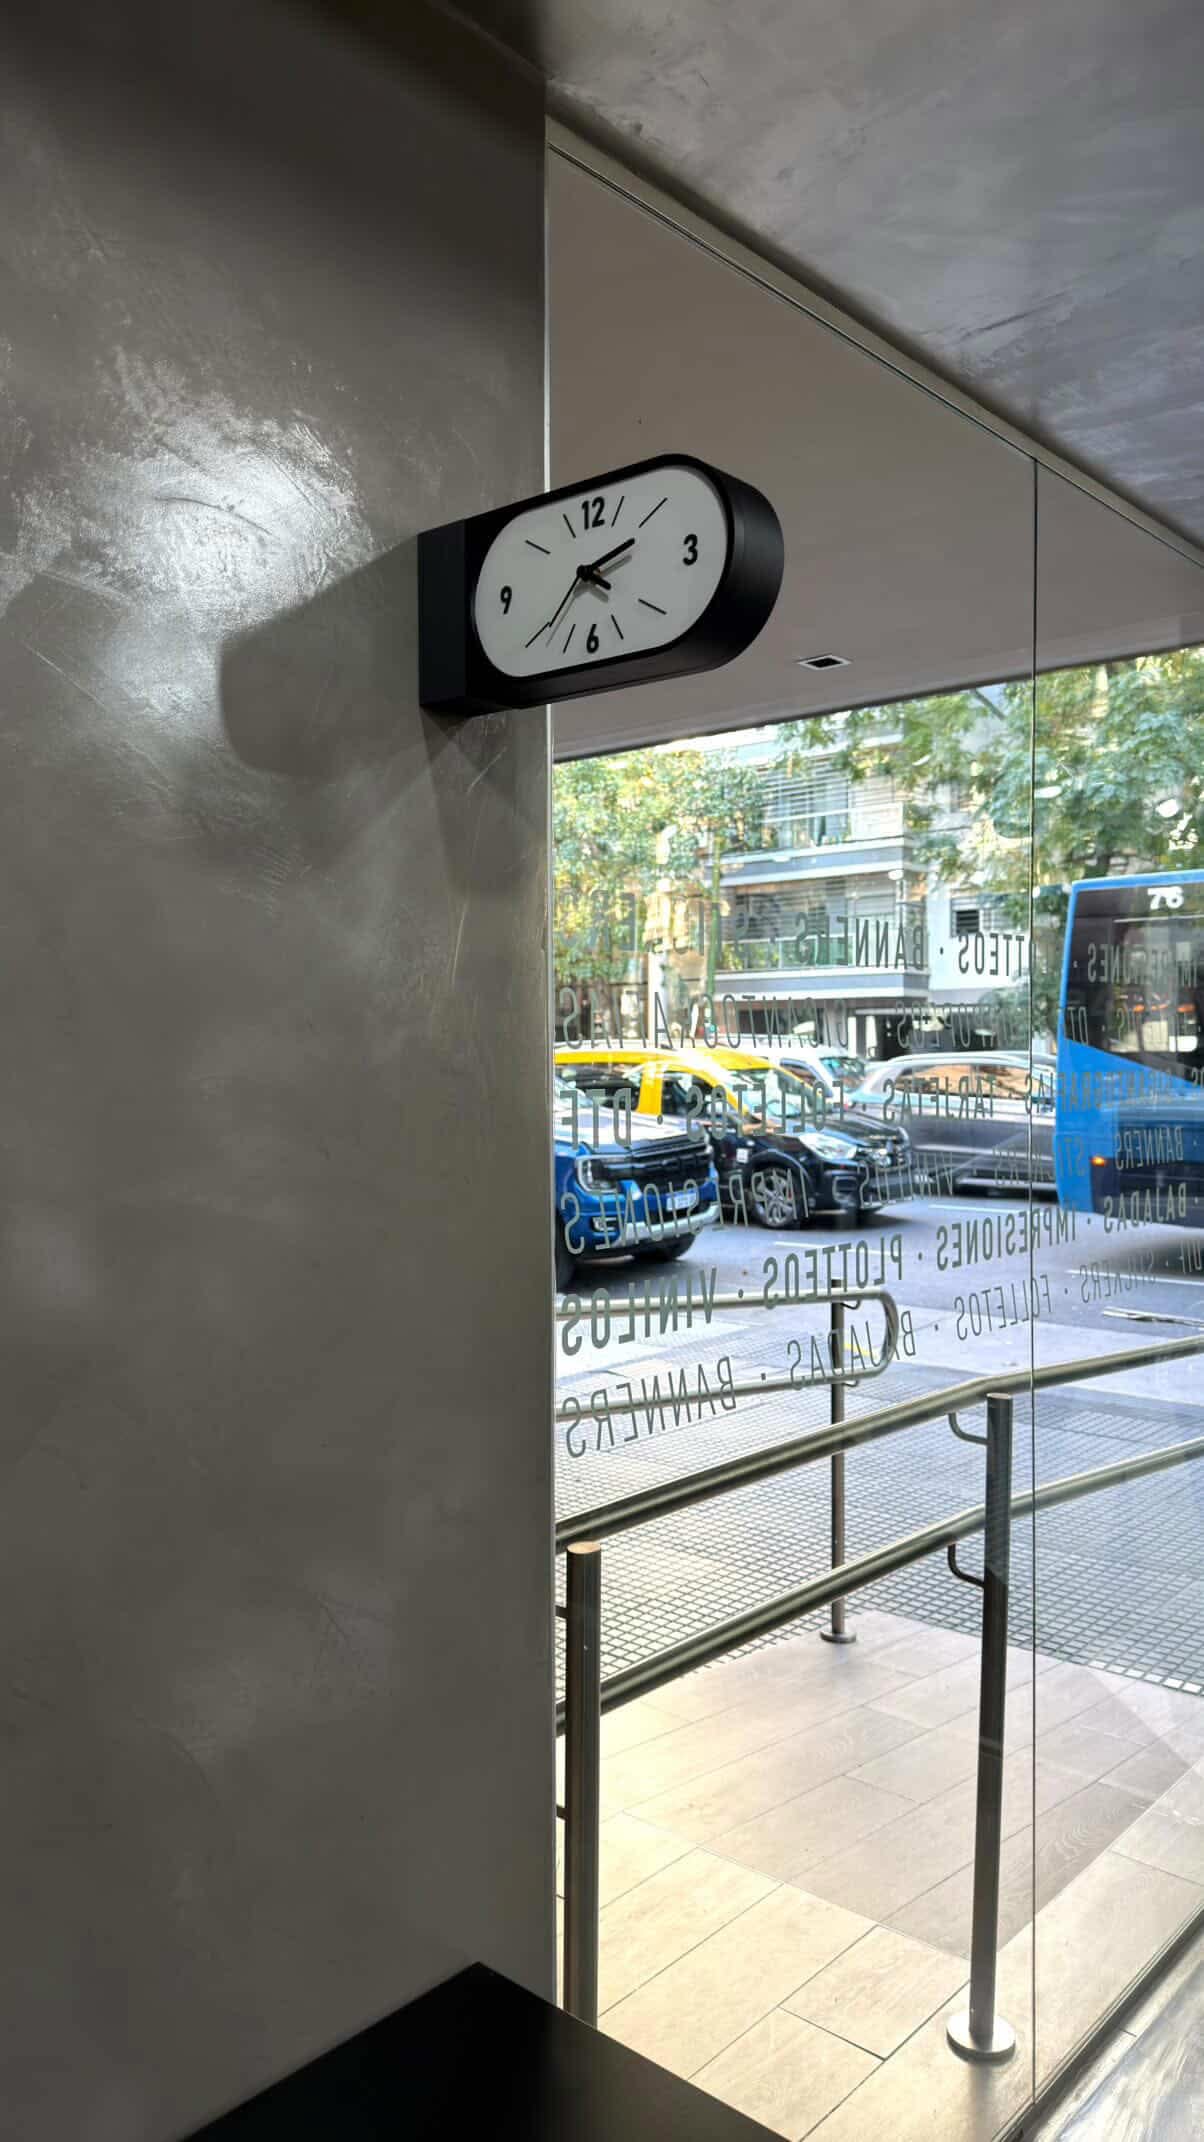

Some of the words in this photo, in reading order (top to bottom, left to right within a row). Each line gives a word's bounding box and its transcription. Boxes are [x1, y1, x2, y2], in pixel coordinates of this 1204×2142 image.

[582, 496, 606, 530] 12
[683, 533, 698, 566] 3
[500, 585, 512, 614] 9
[586, 624, 599, 654] 6
